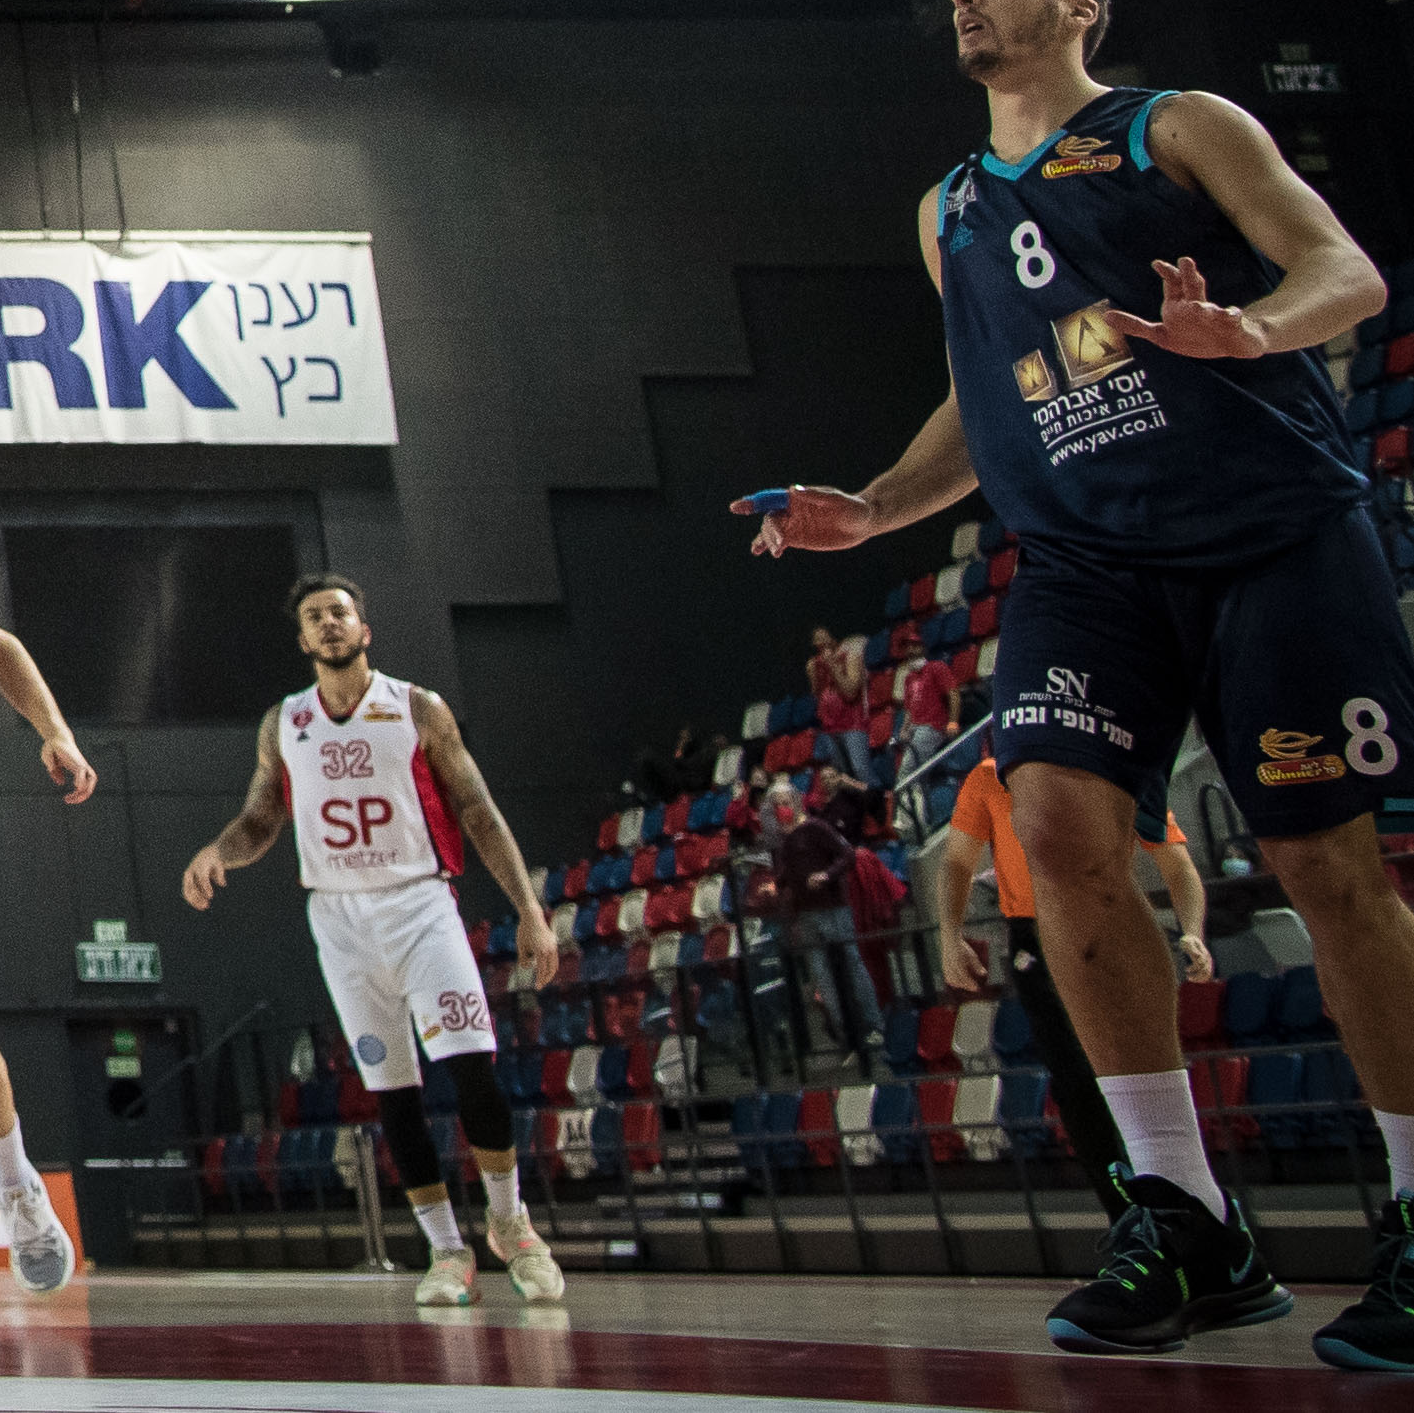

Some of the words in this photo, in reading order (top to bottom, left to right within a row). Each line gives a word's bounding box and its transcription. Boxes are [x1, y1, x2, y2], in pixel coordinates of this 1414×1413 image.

[1010, 221, 1055, 289] 8
[228, 282, 355, 342] רענן
[261, 356, 342, 418] כץ
[1107, 369, 1147, 394] יוסי
[1116, 390, 1156, 410] בונה
[1033, 385, 1103, 426] אברהמי
[1066, 403, 1111, 427] איכות
[1049, 409, 1167, 467] www.yav.co.il
[1046, 666, 1091, 699] SN
[1102, 721, 1134, 751] סמי
[1341, 697, 1399, 776] 8
[320, 739, 374, 779] 32
[1266, 766, 1323, 780] Winner
[321, 796, 393, 850] SP
[438, 991, 490, 1031] 32
